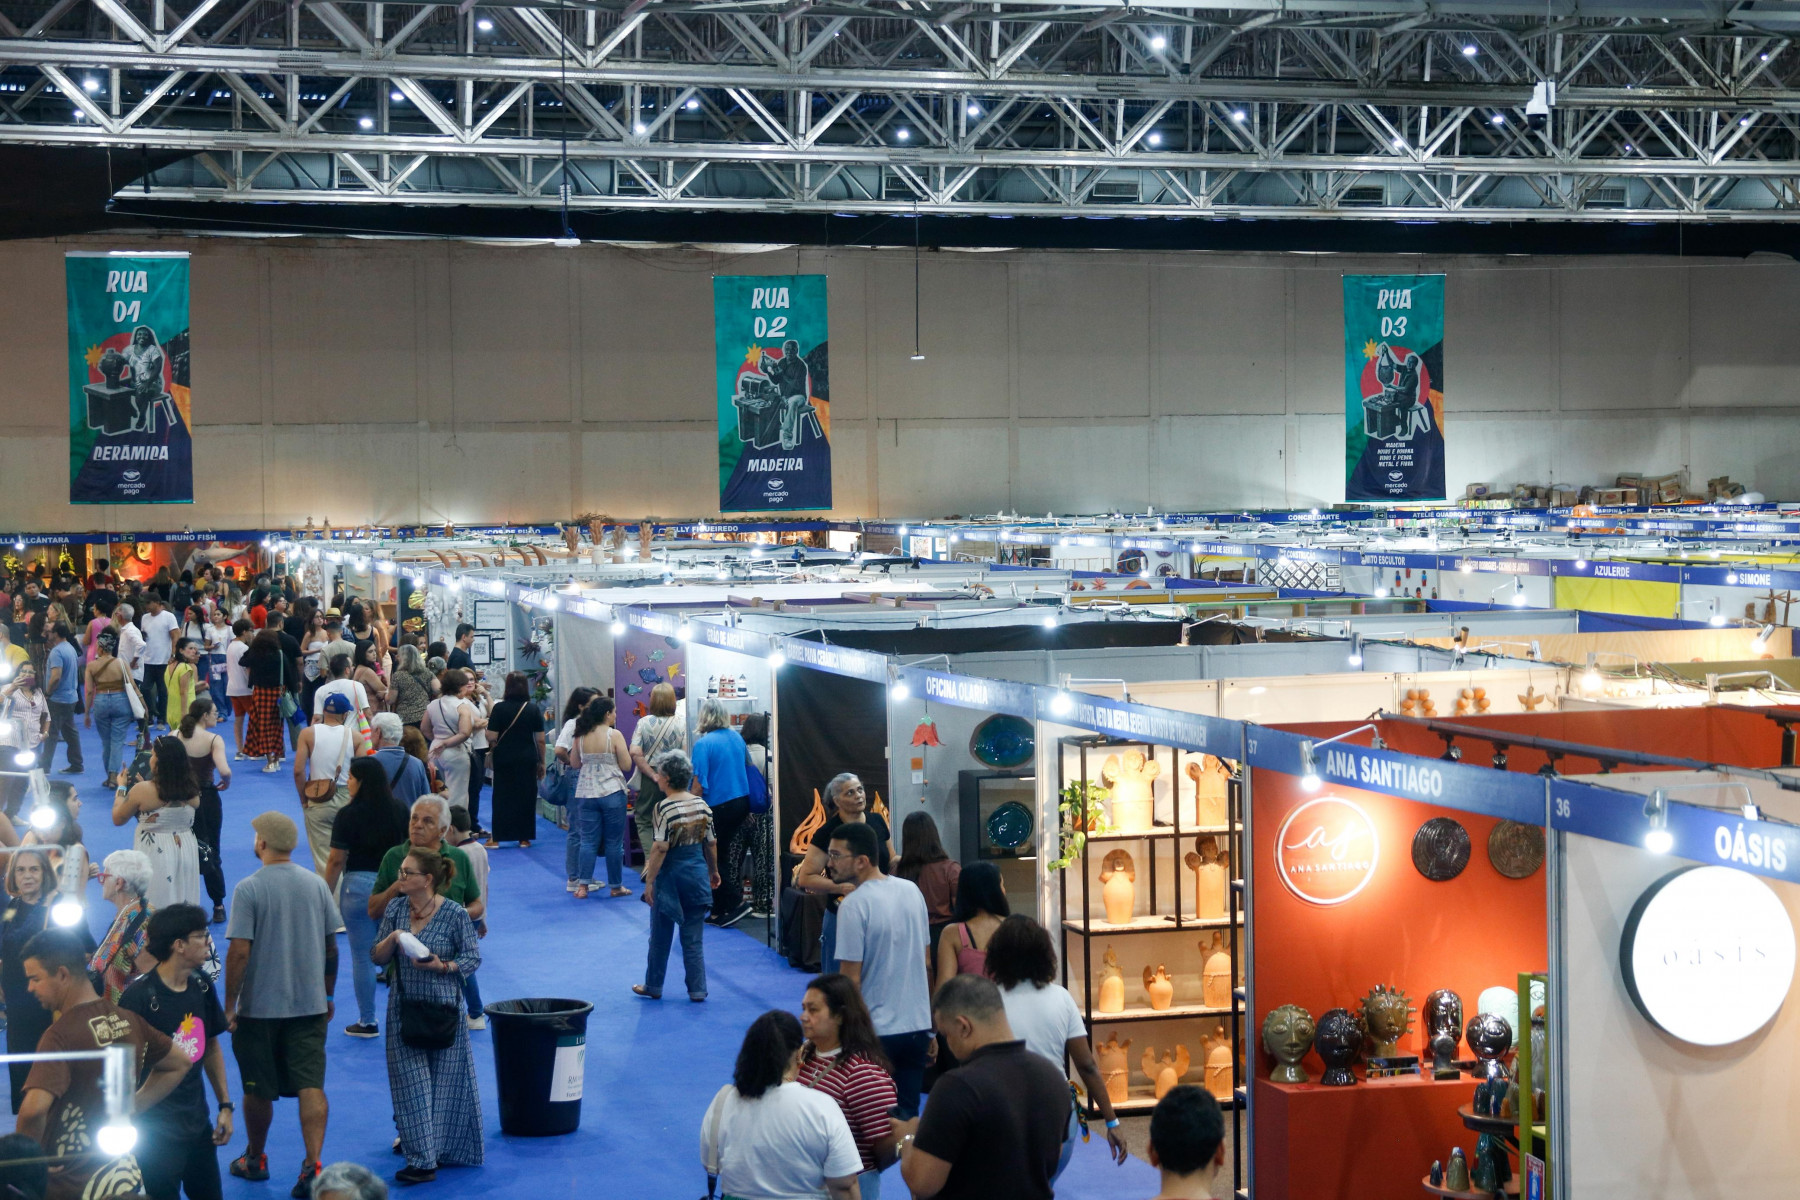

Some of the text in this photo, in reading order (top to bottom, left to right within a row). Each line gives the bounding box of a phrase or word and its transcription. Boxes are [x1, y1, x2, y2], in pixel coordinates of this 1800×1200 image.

[106, 270, 148, 293] RUA
[751, 287, 790, 310] RUA
[1377, 289, 1412, 309] RUA
[112, 300, 141, 323] 01
[754, 316, 788, 338] 02
[1381, 316, 1408, 337] 03
[93, 444, 169, 461] CERÂMICA
[747, 458, 804, 472] MADEIRA
[1287, 513, 1340, 521] CONCREDARTE
[691, 525, 739, 533] FIGUEIREDO
[1217, 545, 1223, 553] DE
[1378, 555, 1406, 566] ESCULTOR
[1552, 565, 1558, 573] 92
[1594, 566, 1630, 578] AZULERDE
[1684, 572, 1690, 580] 91
[1739, 573, 1771, 586] SIMONE
[925, 676, 957, 700] OFICINA
[1113, 708, 1130, 732] MESTRA
[1248, 739, 1258, 755] 37
[1326, 749, 1442, 797] ANA SANTIAGO
[1556, 797, 1571, 818] 36
[1714, 822, 1788, 873] OÁSIS
[1290, 861, 1369, 874] ANA SANTIAGO
